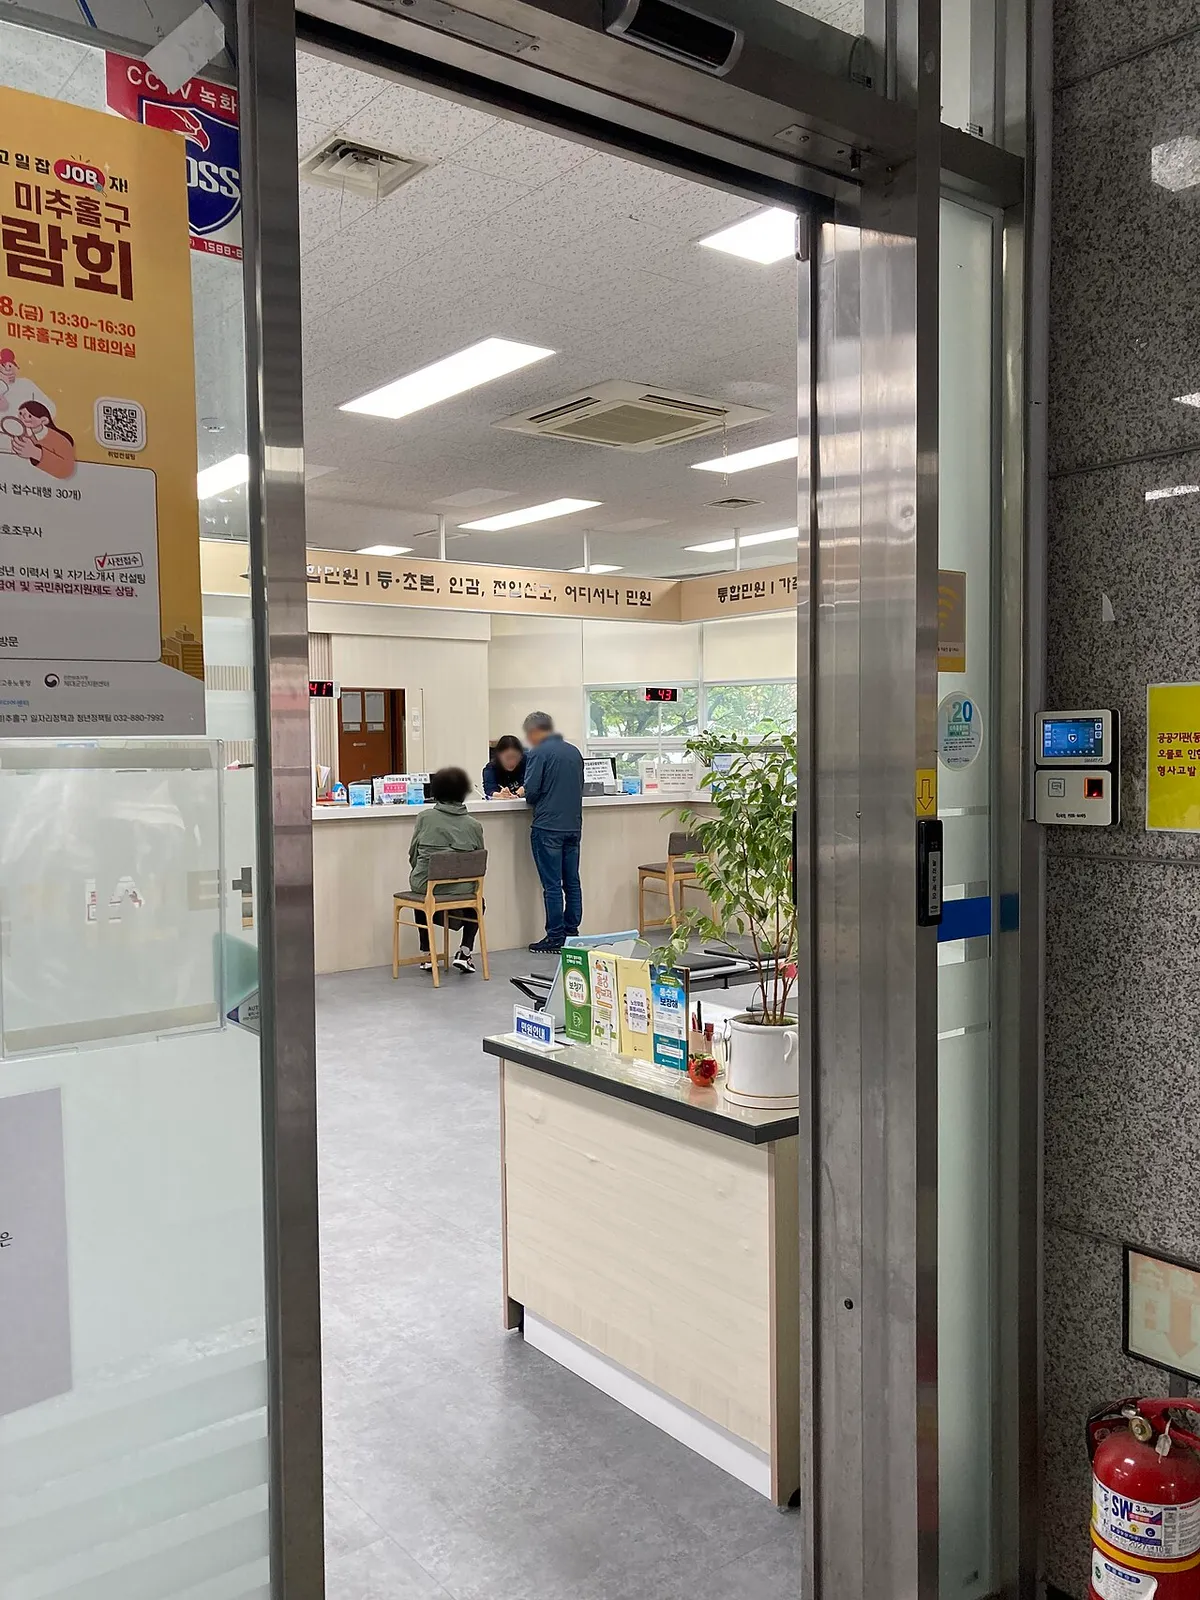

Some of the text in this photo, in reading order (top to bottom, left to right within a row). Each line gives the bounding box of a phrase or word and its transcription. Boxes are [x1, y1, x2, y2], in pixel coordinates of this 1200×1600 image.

[127, 65, 237, 114] CCV 녹화
[60, 164, 98, 185] JOB
[109, 176, 128, 193] 자!
[15, 181, 131, 234] 미추홀구
[1, 215, 133, 301] 람회
[50, 310, 136, 338] 13:30~16:30
[8, 322, 136, 358] 미추홀구청 대회의실
[12, 483, 52, 499] 접수대행
[56, 488, 82, 501] 30개)
[0, 524, 43, 538] 호조무사
[107, 555, 140, 567] 사전접수
[20, 567, 49, 578] 이력서
[53, 568, 63, 579] 및
[67, 569, 115, 583] 자기소개서
[119, 572, 146, 584] 컨설팅
[20, 580, 30, 593] 및
[34, 581, 112, 596] 국민취업지원제도
[115, 586, 138, 598] 상담.
[449, 577, 485, 598] 인감,
[565, 585, 620, 605] 어디서나
[626, 590, 652, 607] 민원
[717, 581, 766, 603] 통합민원
[658, 690, 672, 701] 43
[1112, 1494, 1134, 1522] SW
